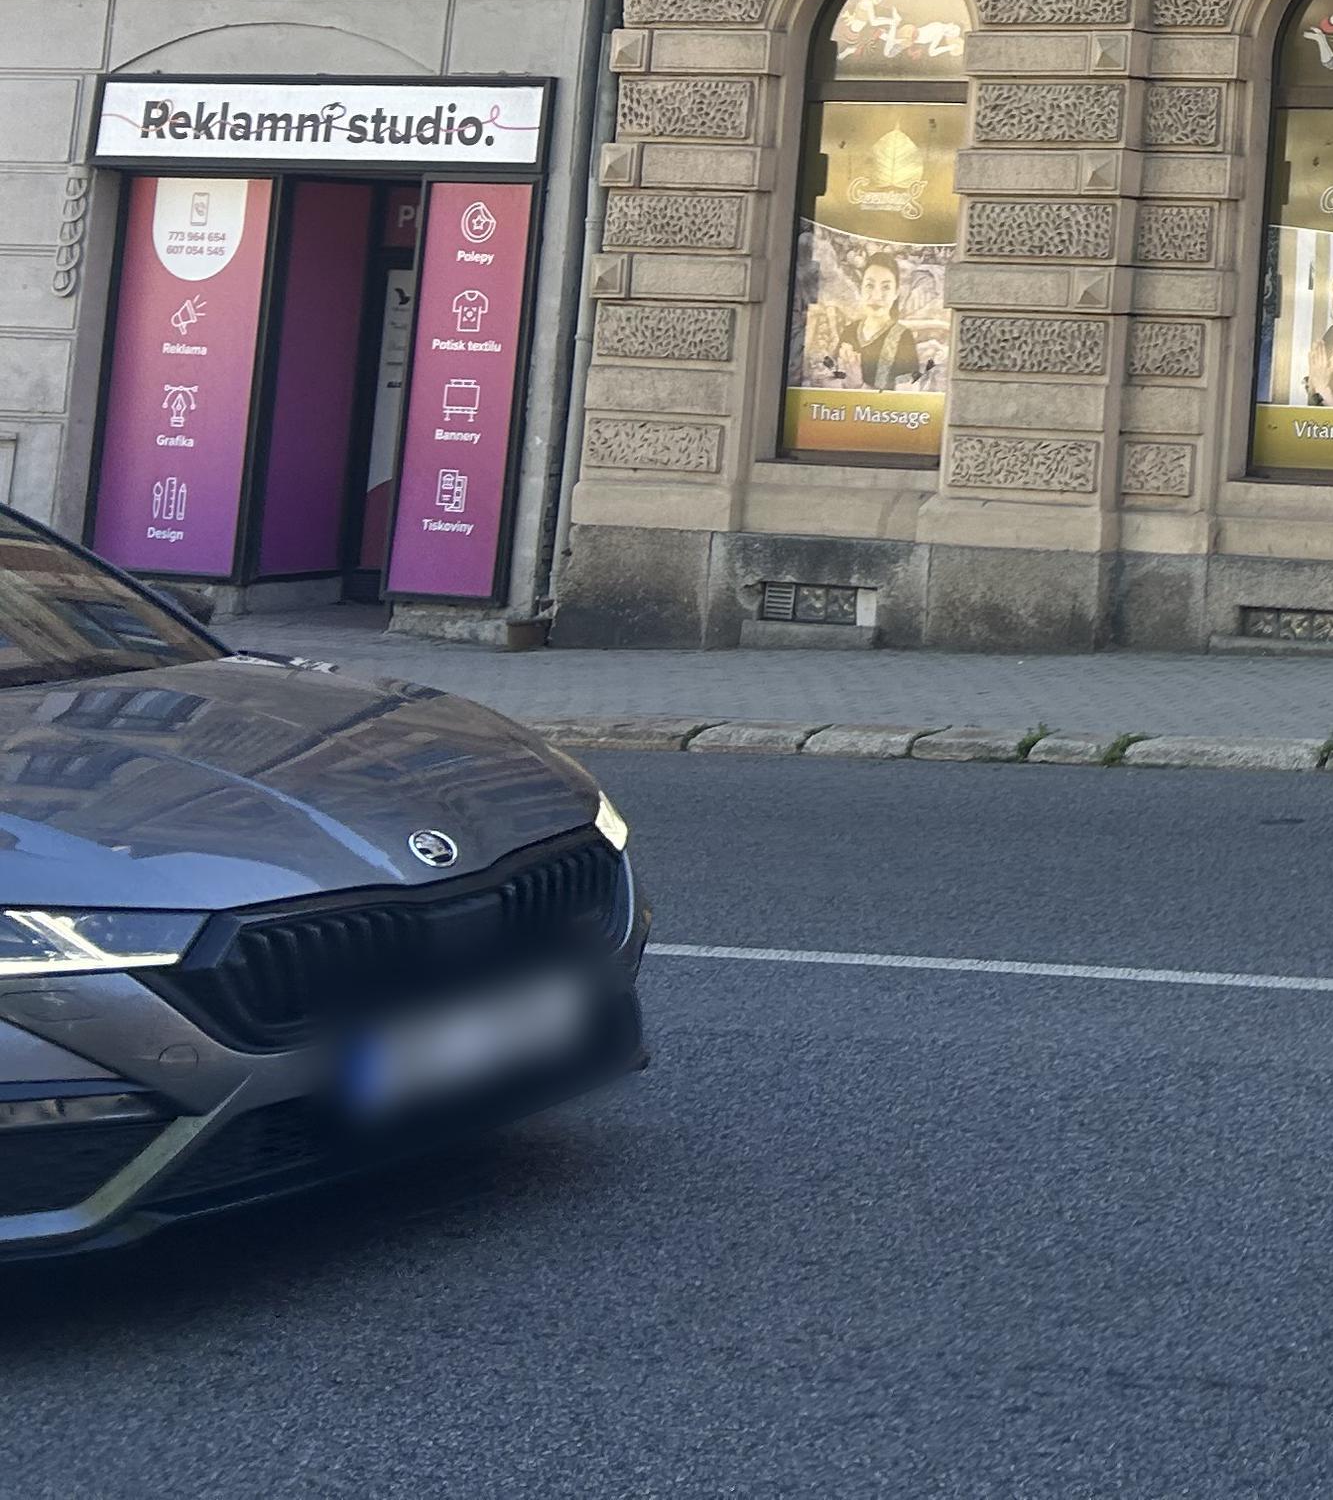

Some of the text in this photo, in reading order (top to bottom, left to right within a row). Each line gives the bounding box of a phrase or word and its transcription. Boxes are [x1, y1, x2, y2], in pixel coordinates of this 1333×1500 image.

[140, 100, 494, 146] Reklamní studio.
[168, 231, 185, 241] 773
[456, 250, 495, 265] Polepy
[162, 342, 207, 355] Reklama
[432, 339, 501, 352] Potisk textilu
[810, 403, 931, 429] Thai Massage
[156, 435, 195, 448] Grafika
[434, 428, 481, 444] Bannery
[147, 527, 184, 542] Design
[422, 519, 474, 535] Tiskoviny
